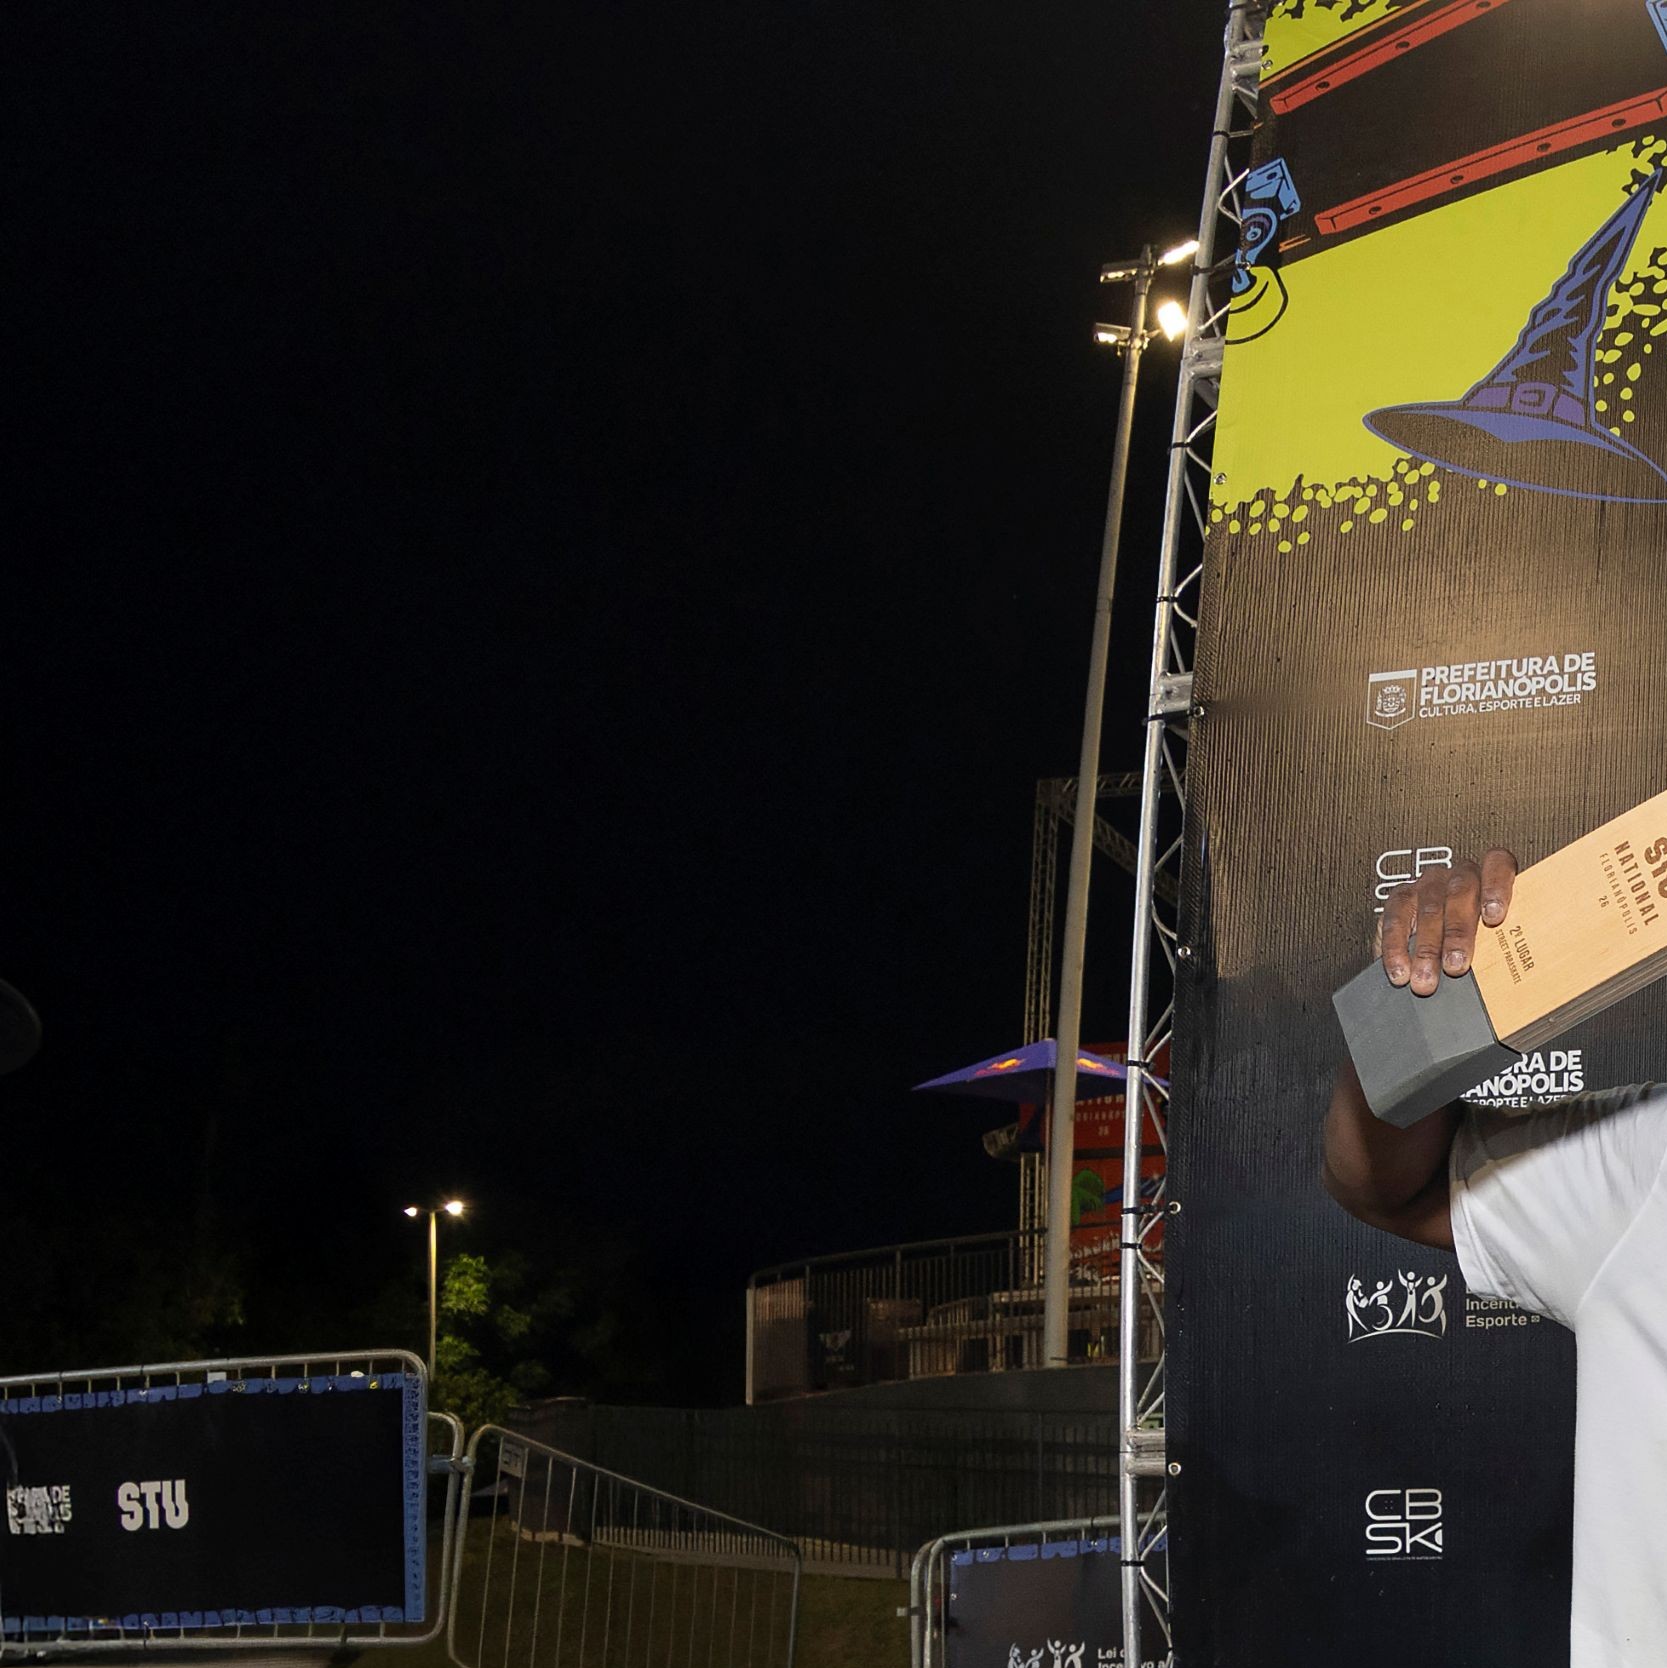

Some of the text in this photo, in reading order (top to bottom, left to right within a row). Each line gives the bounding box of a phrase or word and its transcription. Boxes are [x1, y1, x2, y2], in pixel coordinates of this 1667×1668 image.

[1421, 651, 1596, 685] PREFEITURA DE
[1420, 669, 1597, 706] FLORIANÓPOLIS
[1418, 693, 1582, 719] CULTURA, ESPORTE LAZER
[1599, 852, 1639, 936] FLORIANÓPOLIS
[1614, 840, 1659, 928] NATIONAL
[1598, 895, 1608, 910] 26
[1495, 929, 1521, 985] STREET PARASKATE
[1513, 939, 1535, 973] LUGAR
[1465, 1312, 1527, 1330] Esporte
[117, 1479, 189, 1532] STU
